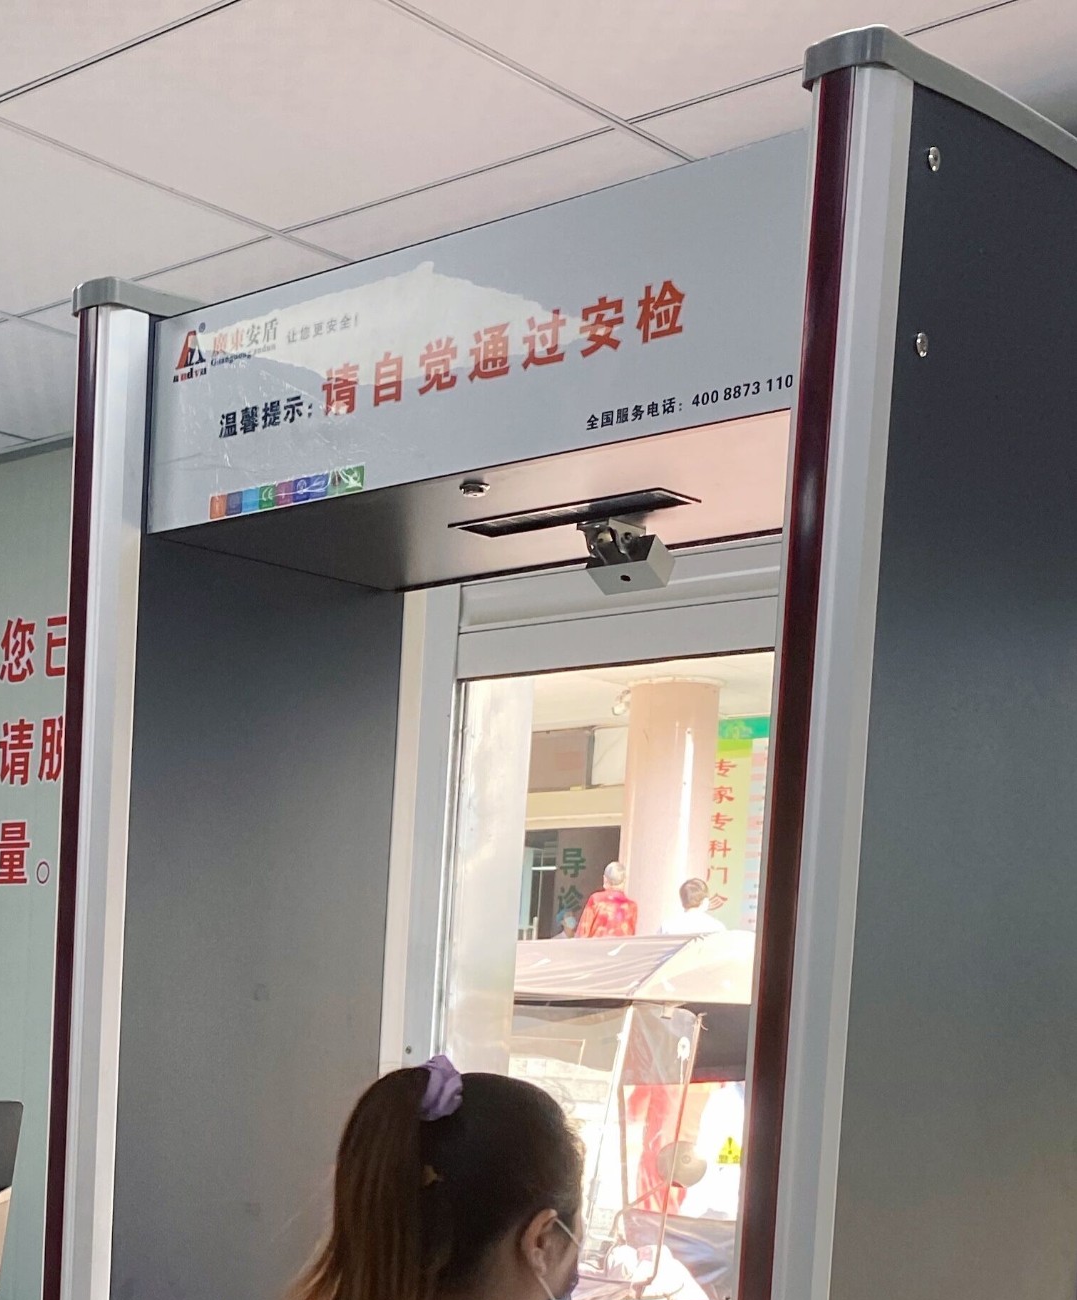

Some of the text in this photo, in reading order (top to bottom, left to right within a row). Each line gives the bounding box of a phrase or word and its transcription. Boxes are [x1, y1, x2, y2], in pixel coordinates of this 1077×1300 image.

[322, 279, 686, 417] 请自觉通过安检
[691, 389, 719, 408] 400
[723, 381, 761, 401] 8873
[766, 374, 794, 393] 110
